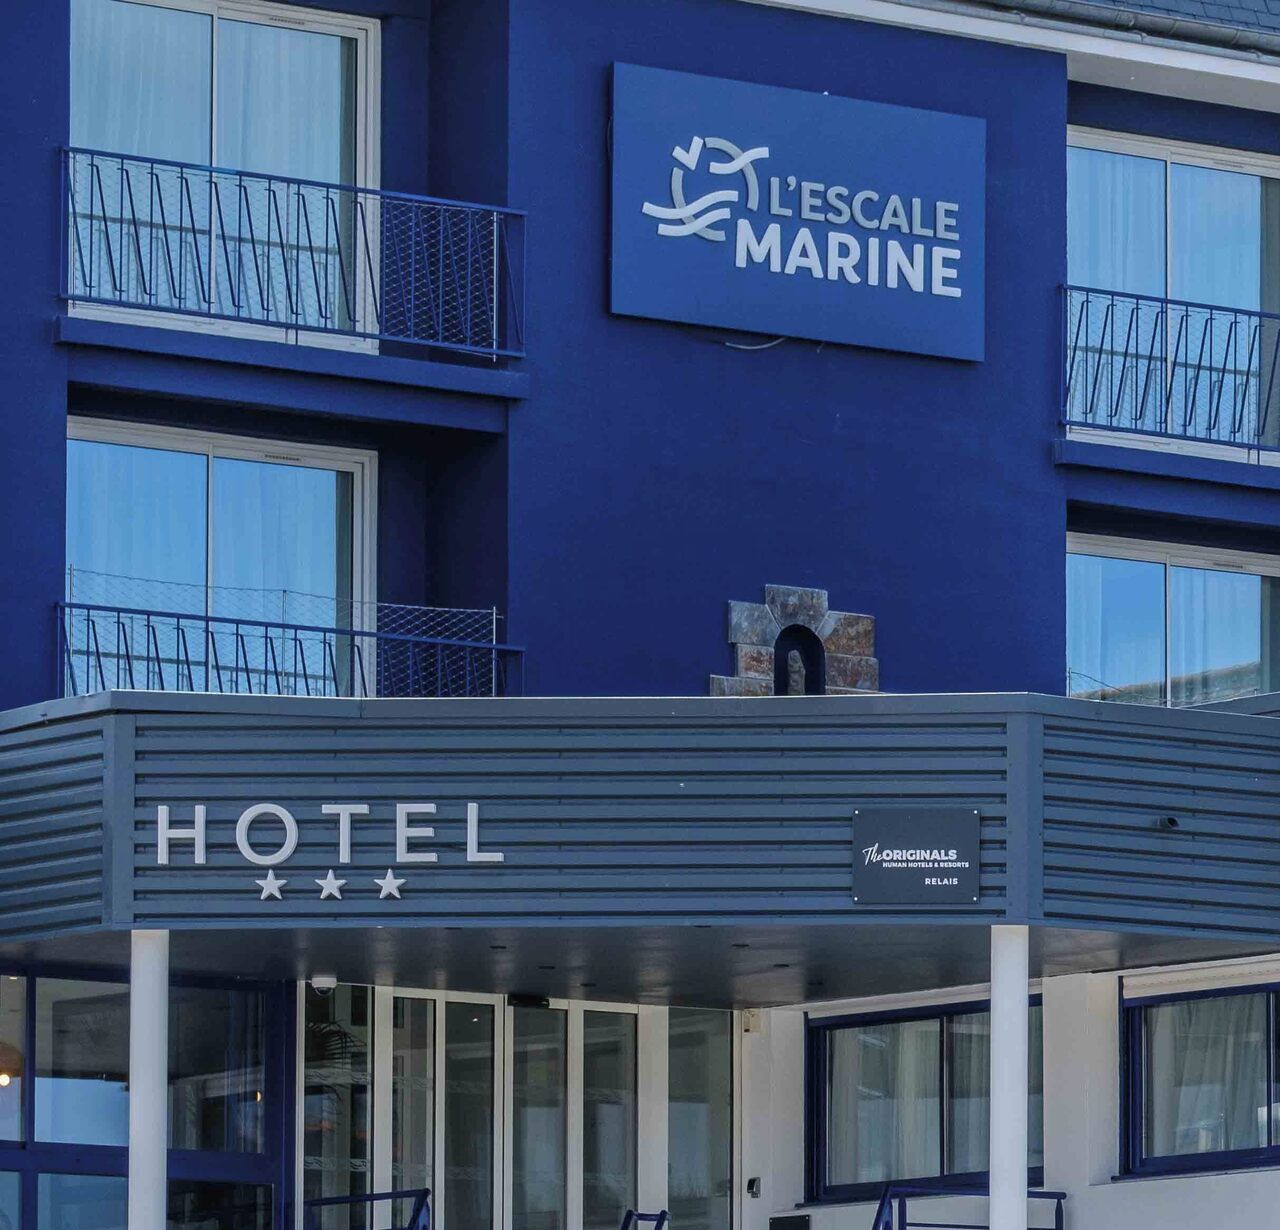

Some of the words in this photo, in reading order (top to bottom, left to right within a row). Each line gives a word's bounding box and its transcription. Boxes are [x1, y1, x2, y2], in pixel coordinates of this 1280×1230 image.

[735, 218, 962, 299] MARINE
[157, 802, 505, 866] HOTEL
[862, 842, 884, 866] The
[882, 849, 958, 861] ORIGINALS
[924, 877, 958, 885] RELAIS
